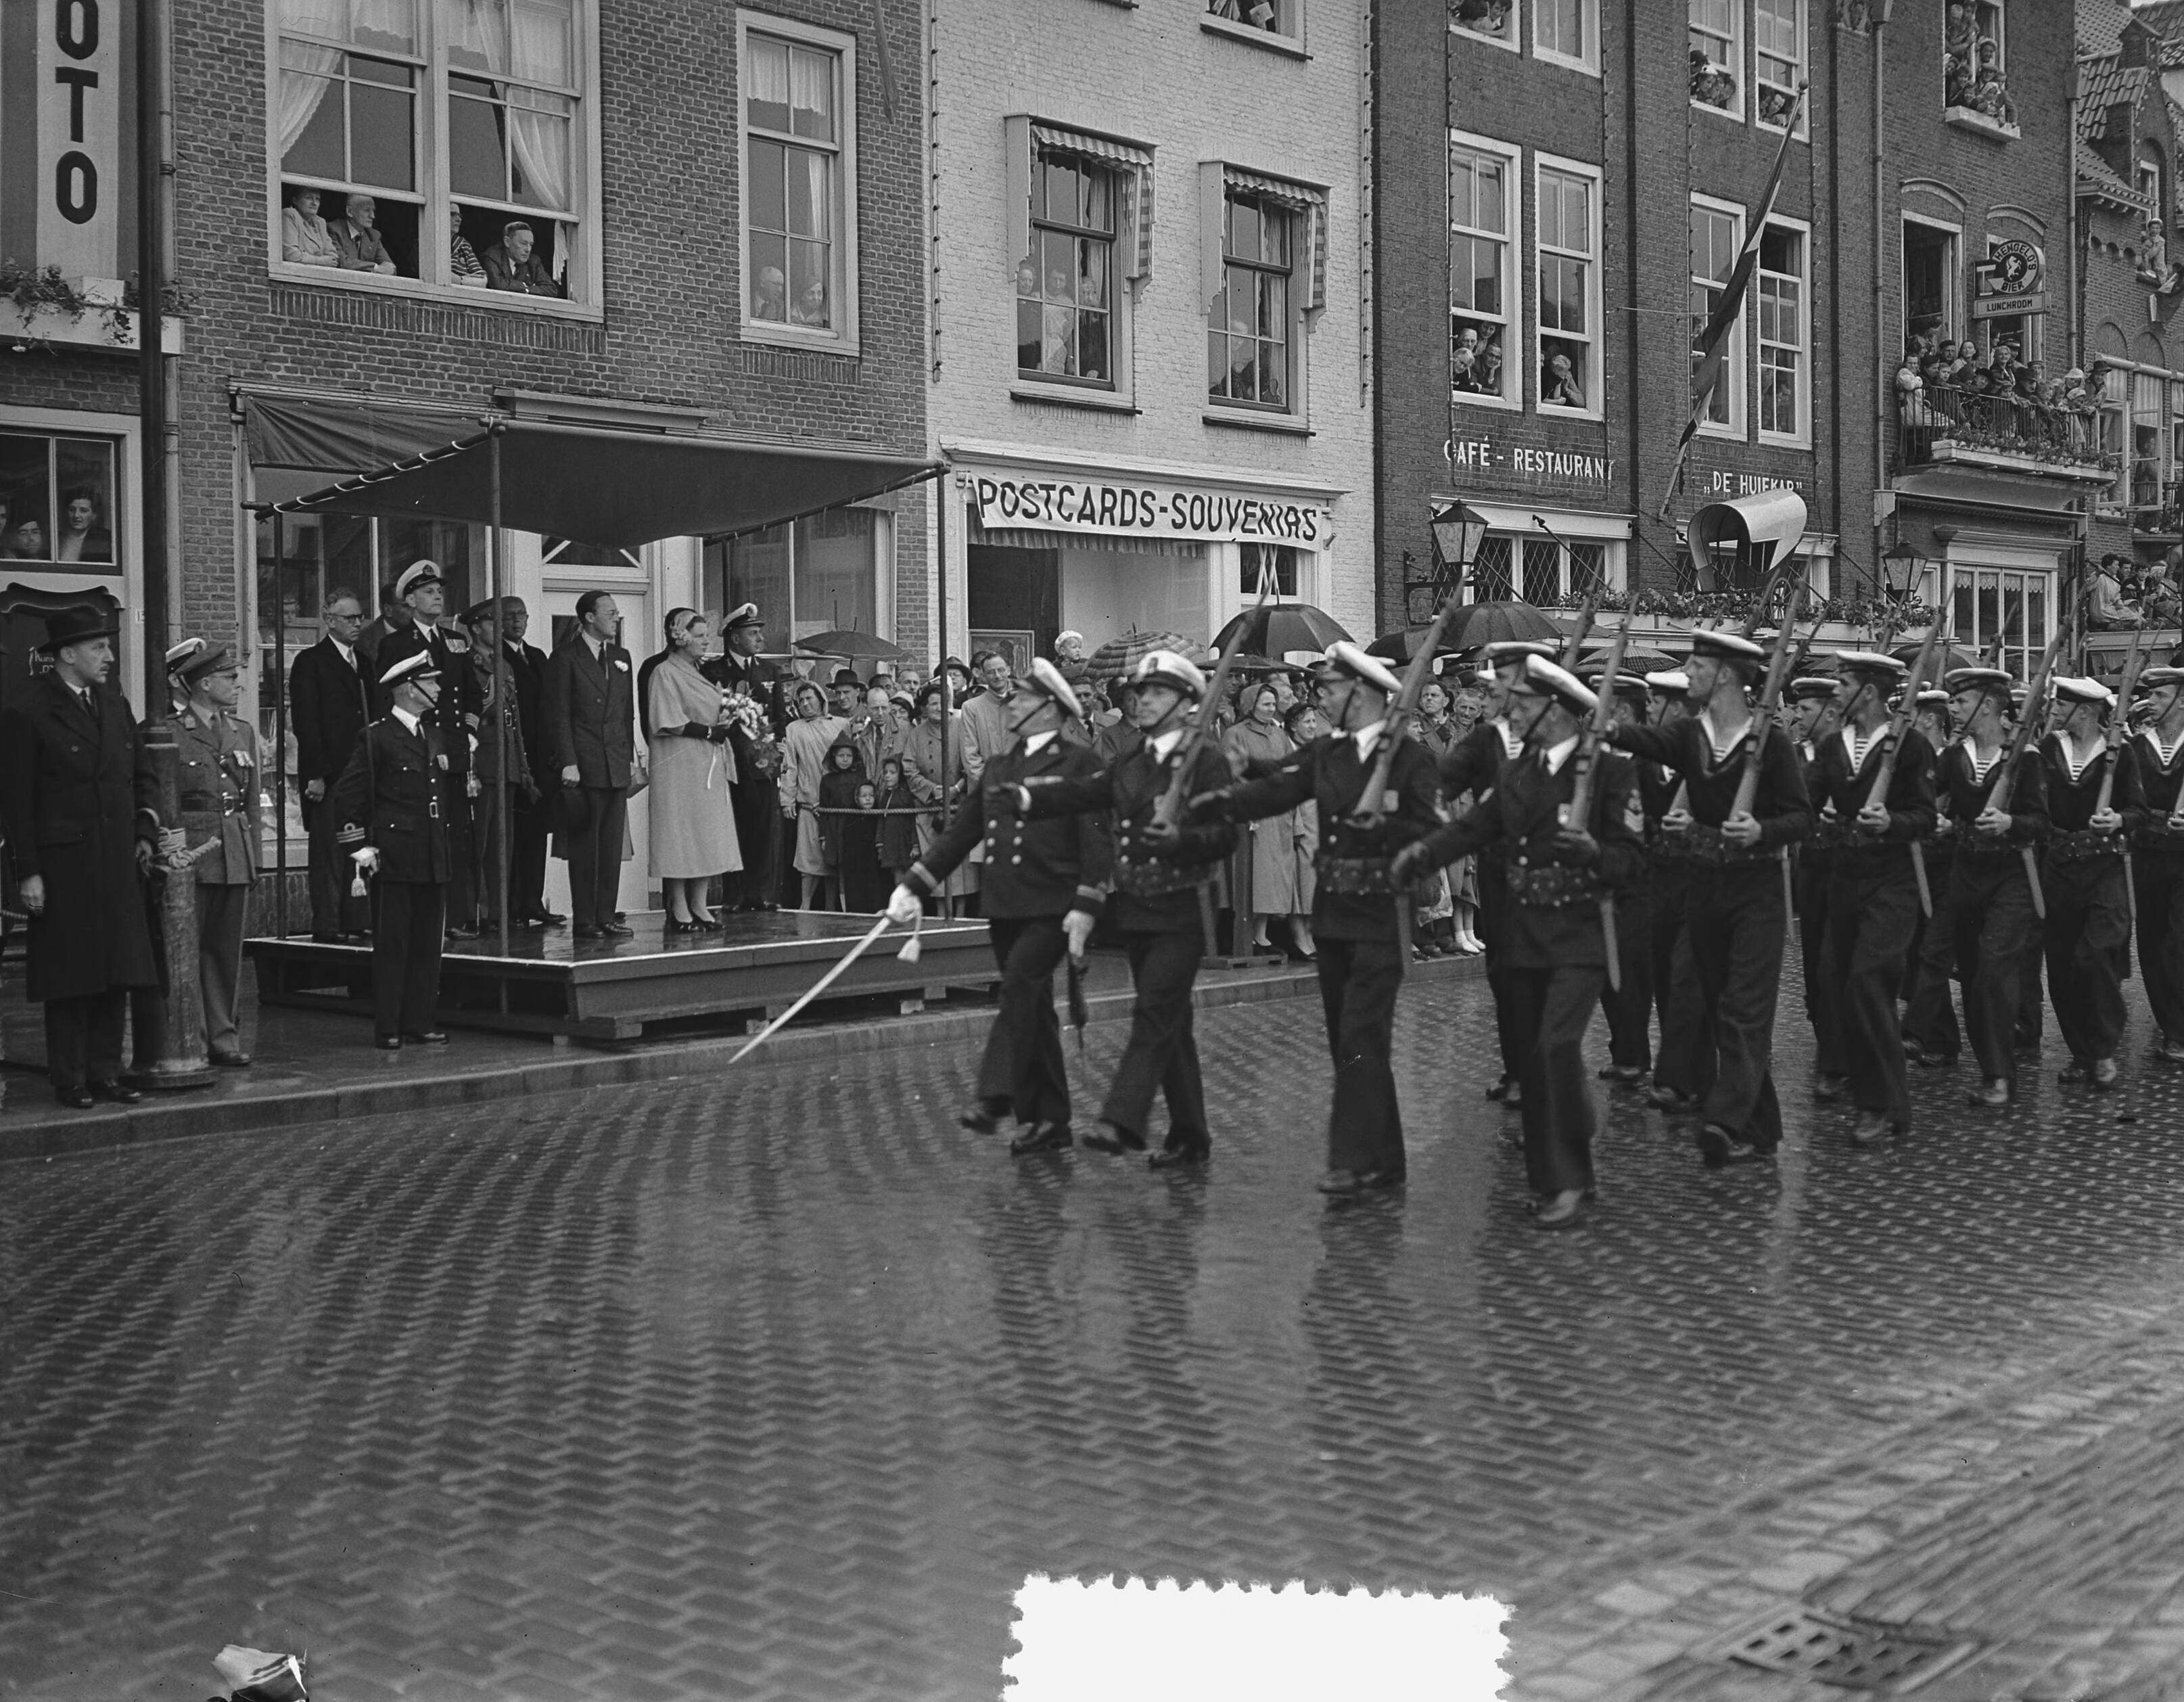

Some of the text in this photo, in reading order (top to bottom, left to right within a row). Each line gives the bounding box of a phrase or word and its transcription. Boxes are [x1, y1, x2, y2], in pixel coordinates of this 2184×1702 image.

[55, 0, 98, 224] OTO
[1995, 243, 2037, 270] HENGELO'S
[2001, 281, 2025, 292] BIER
[1986, 298, 2033, 312] LUNCHROOM
[1444, 435, 1491, 467] CAFÉ
[1514, 448, 1614, 480] RESTAURANT
